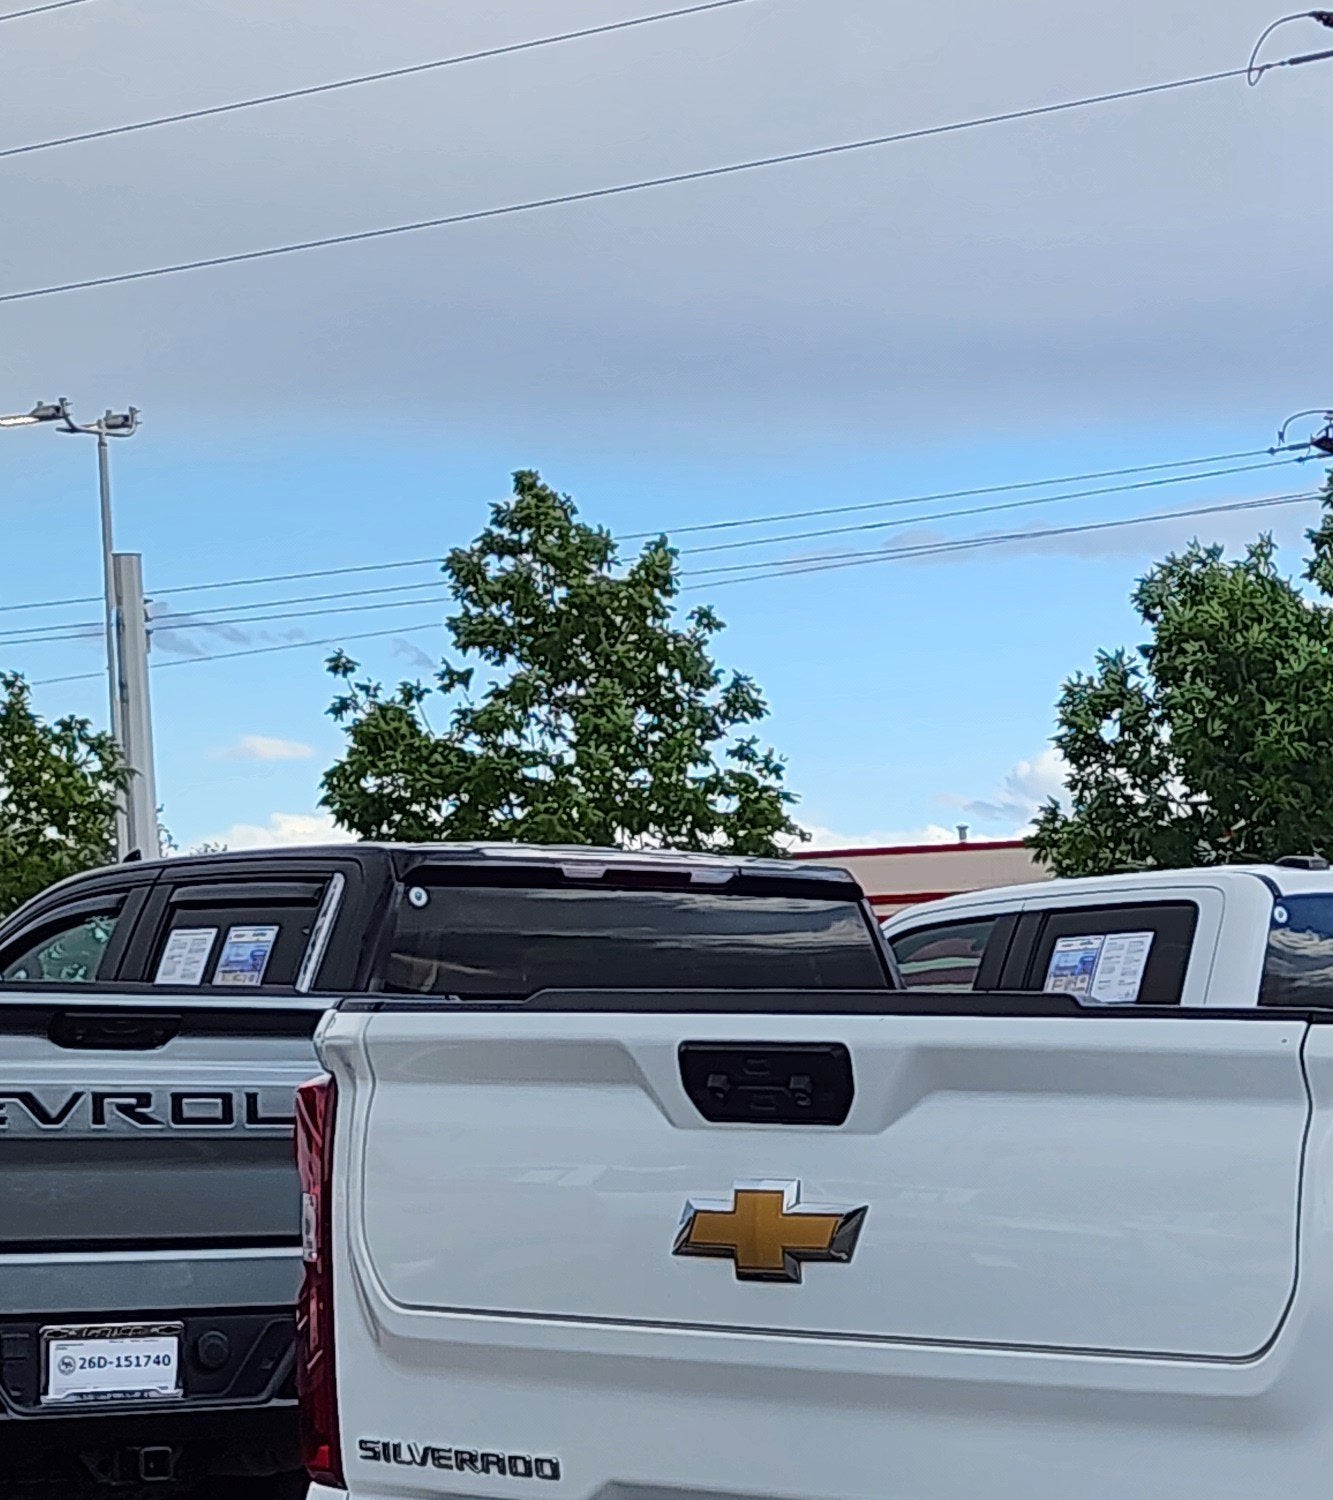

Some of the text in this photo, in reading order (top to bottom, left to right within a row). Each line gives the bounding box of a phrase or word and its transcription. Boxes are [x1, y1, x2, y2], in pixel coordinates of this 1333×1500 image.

[0, 1091, 296, 1128] VROL
[78, 1354, 171, 1370] 26D-151740
[358, 1439, 561, 1481] SILVERADO
